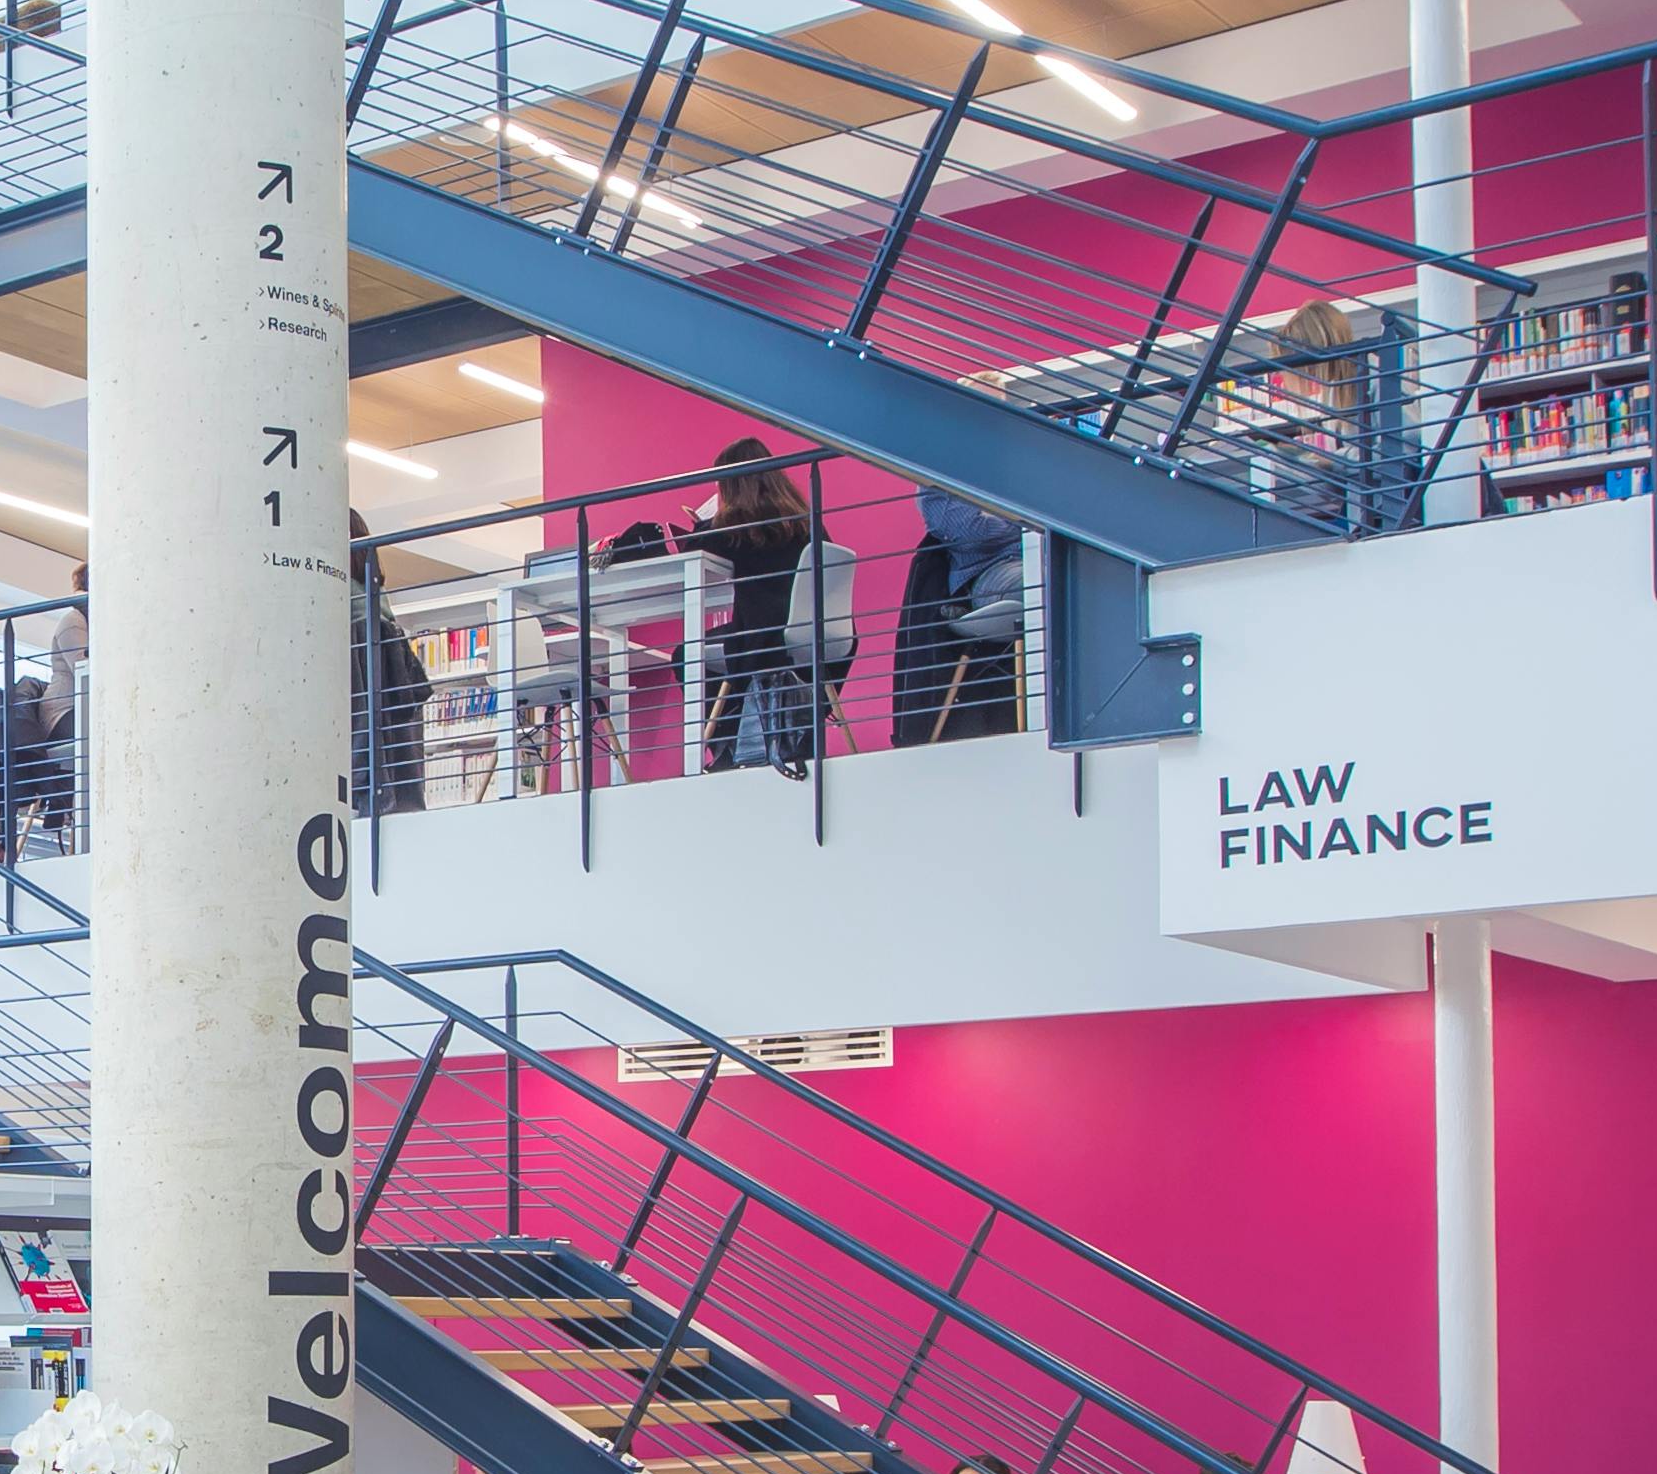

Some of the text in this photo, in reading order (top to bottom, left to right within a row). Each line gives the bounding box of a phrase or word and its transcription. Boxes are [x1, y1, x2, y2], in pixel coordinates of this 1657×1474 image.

[259, 224, 283, 260] 2
[267, 285, 309, 305] Wines
[312, 294, 320, 308] &
[268, 317, 327, 342] Research
[264, 491, 280, 526] 1
[273, 552, 301, 568] Law
[305, 557, 313, 571] &
[1219, 762, 1355, 816] LAW
[1220, 801, 1492, 869] FINANCE
